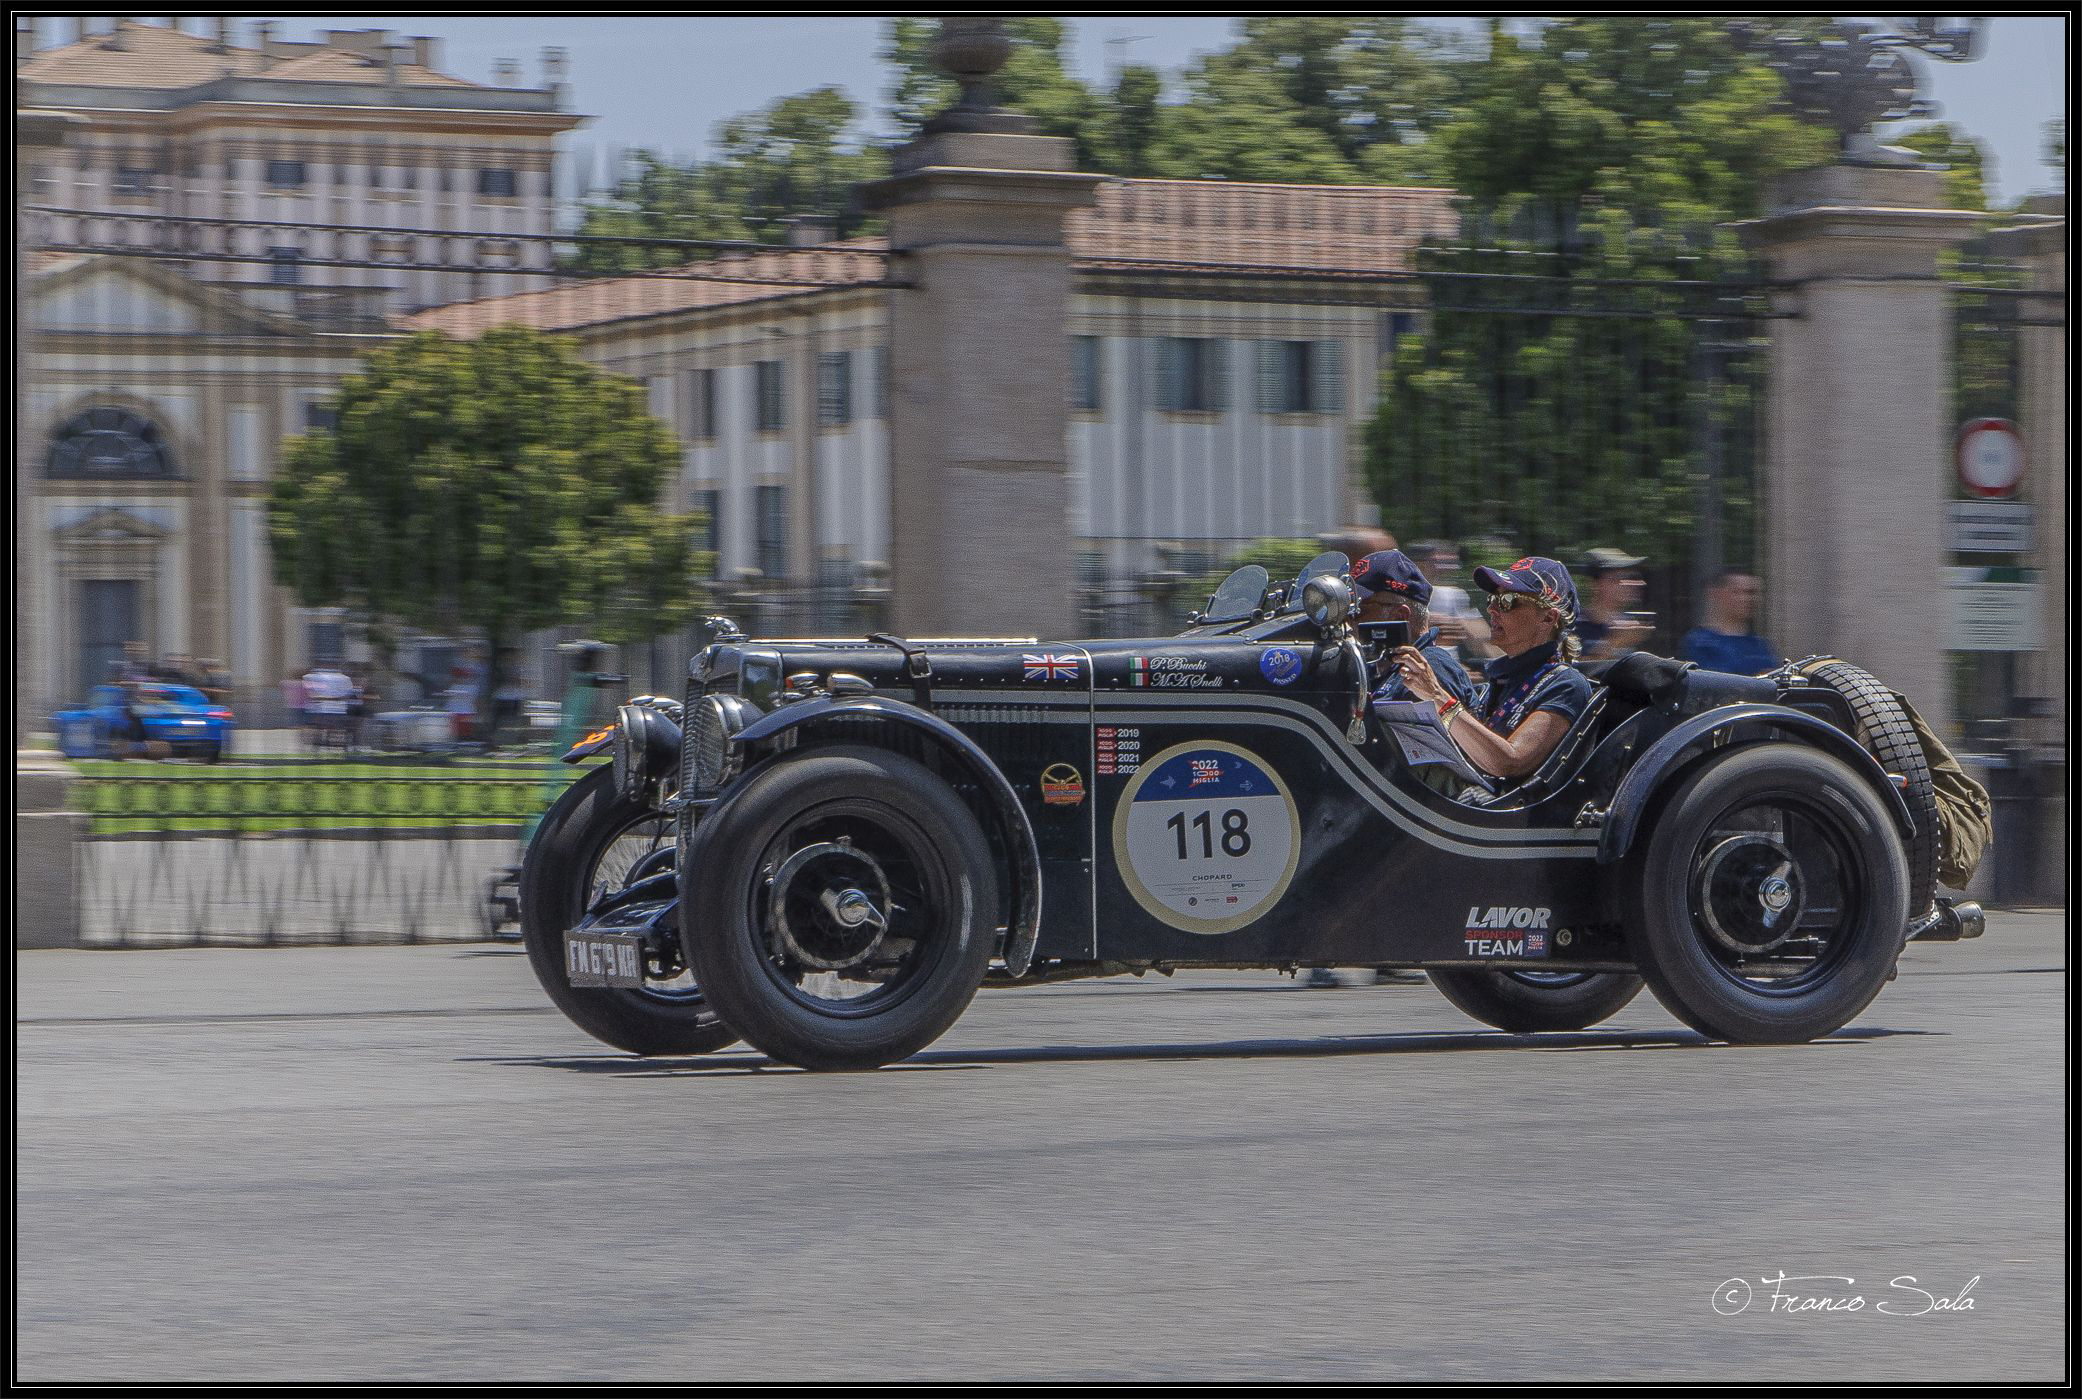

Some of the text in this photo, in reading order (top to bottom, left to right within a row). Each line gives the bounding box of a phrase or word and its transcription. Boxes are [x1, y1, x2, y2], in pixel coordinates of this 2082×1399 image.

[1117, 728, 1140, 738] 2019
[1117, 741, 1140, 750] 2020
[1117, 754, 1140, 762] 2021
[1117, 765, 1140, 774] 2022
[1192, 760, 1219, 770] 2022
[1167, 808, 1252, 860] 118
[1466, 907, 1552, 928] LAVOR
[1464, 930, 1524, 940] SPONSOR
[1464, 940, 1523, 956] TEAM
